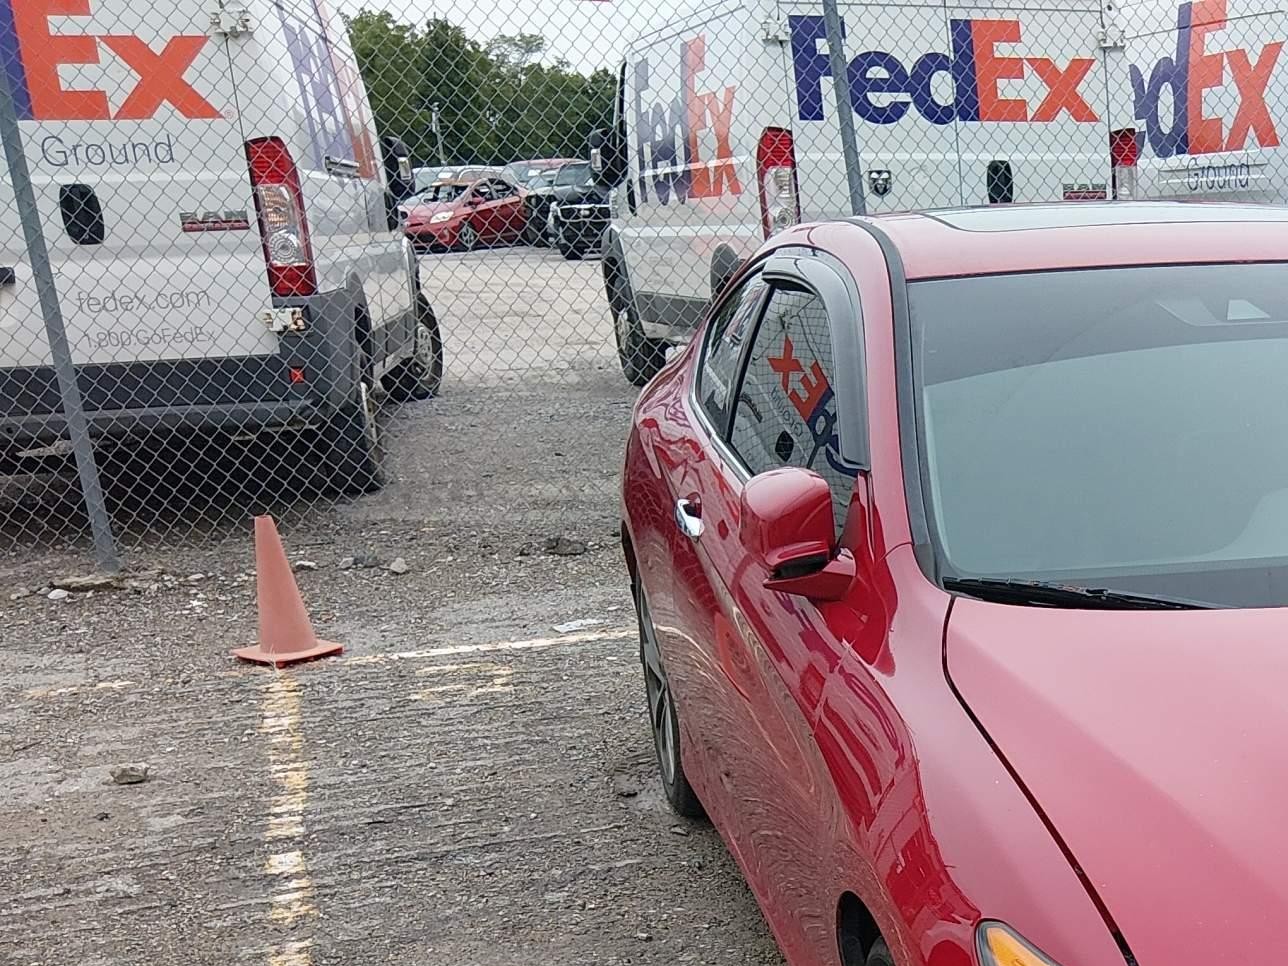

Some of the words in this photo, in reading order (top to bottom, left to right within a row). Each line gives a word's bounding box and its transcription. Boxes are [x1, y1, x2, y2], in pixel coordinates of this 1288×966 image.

[788, 14, 1101, 125] FedEx
[634, 33, 743, 206] FedEx
[41, 134, 176, 167] Ground
[1186, 152, 1250, 191] Ground
[78, 289, 211, 314] fedex.com
